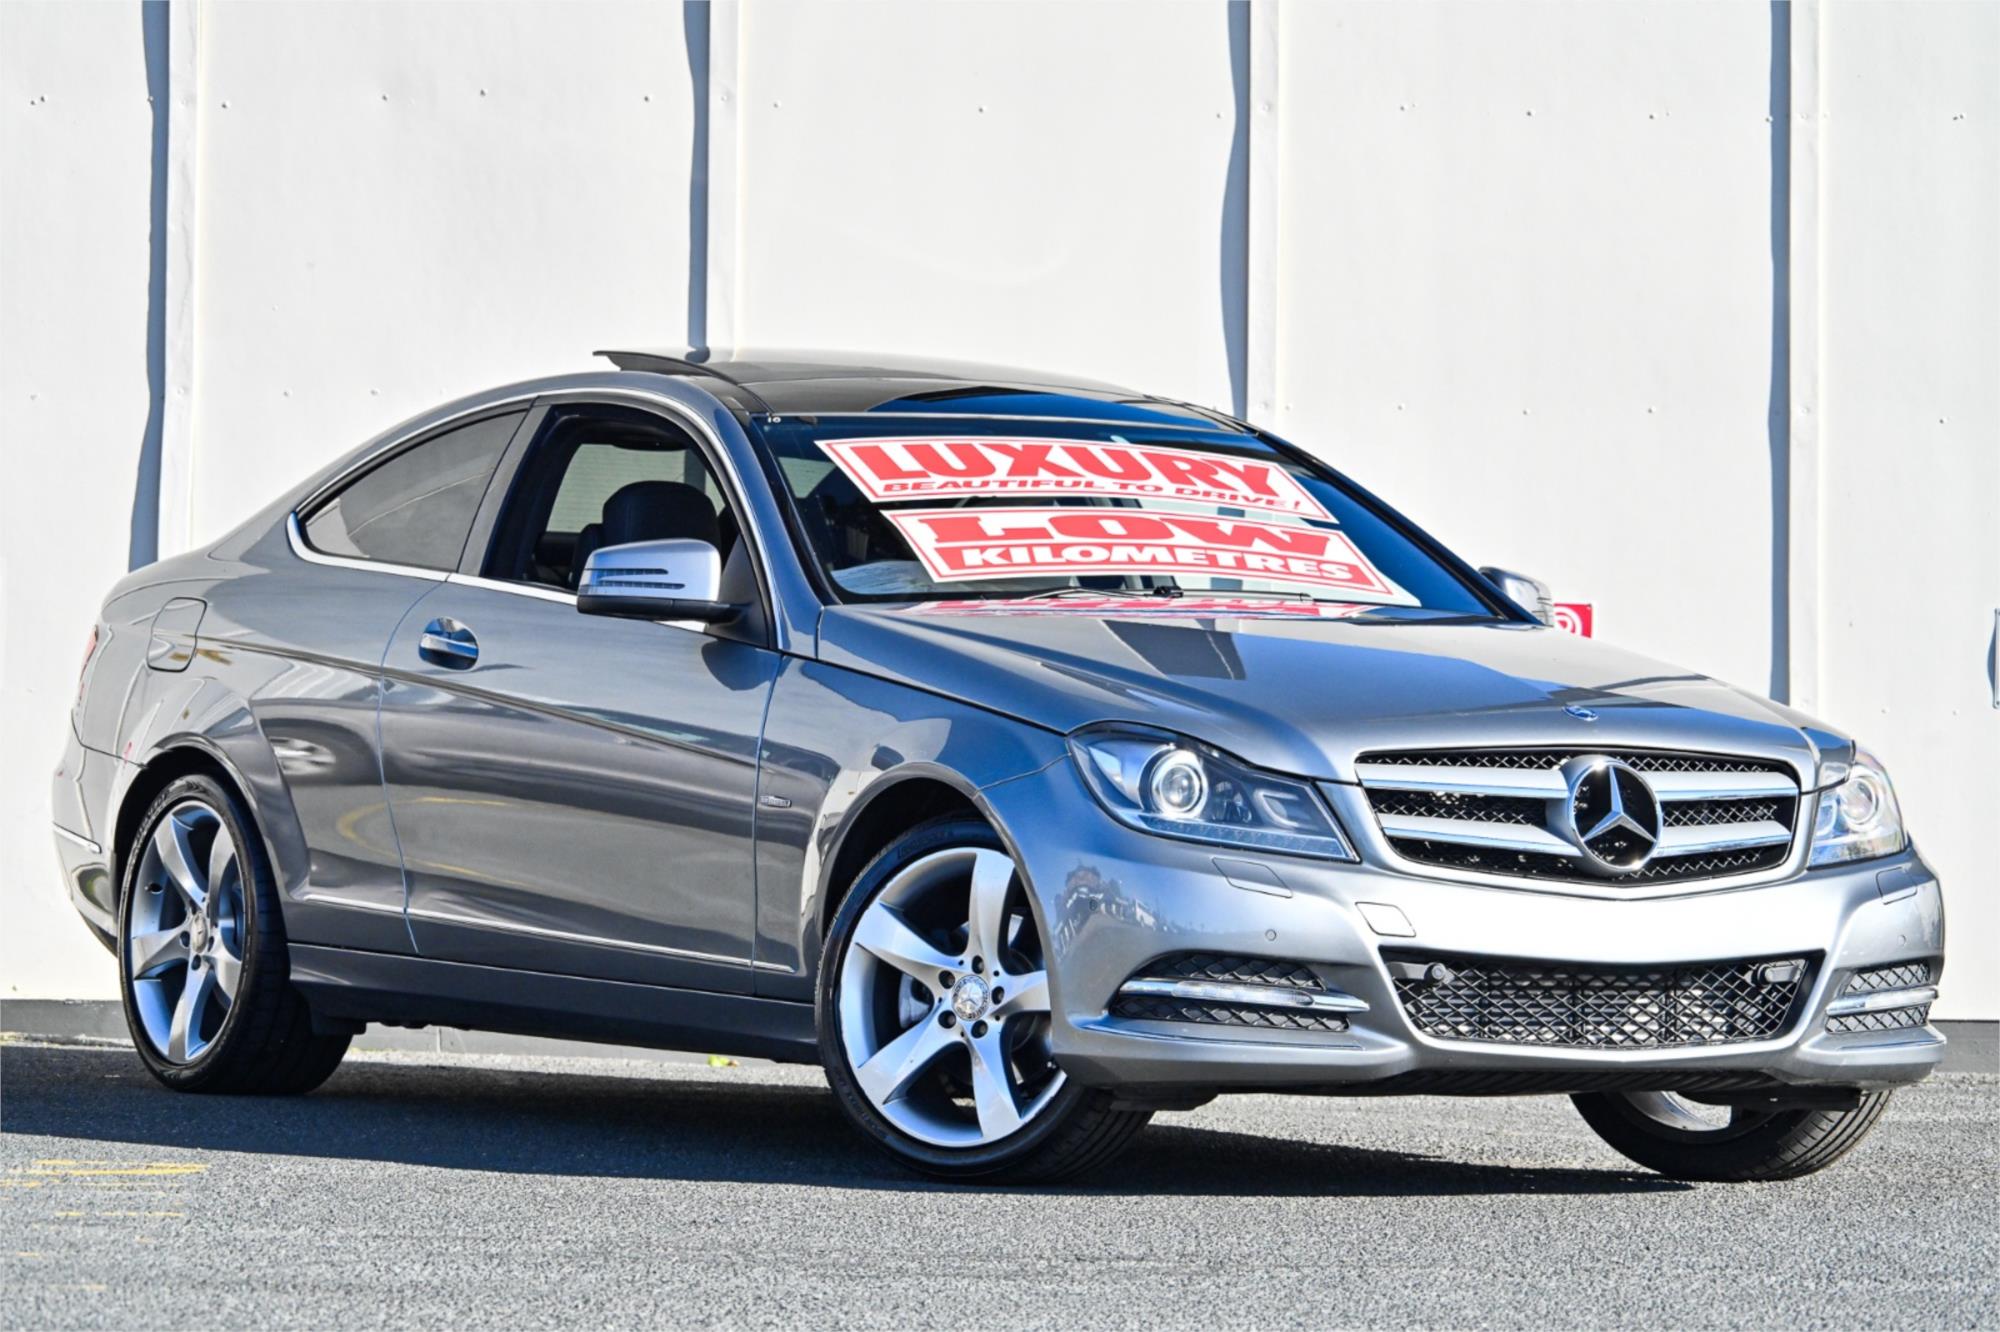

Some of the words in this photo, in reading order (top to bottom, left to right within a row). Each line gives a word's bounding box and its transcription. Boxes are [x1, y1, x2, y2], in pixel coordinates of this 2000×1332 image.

[849, 443, 1280, 498] LUXURY
[883, 479, 1104, 492] BEAUTIFUL
[1112, 481, 1164, 491] TO
[918, 514, 1330, 557] LOW
[961, 545, 1353, 580] KILOMETRES
